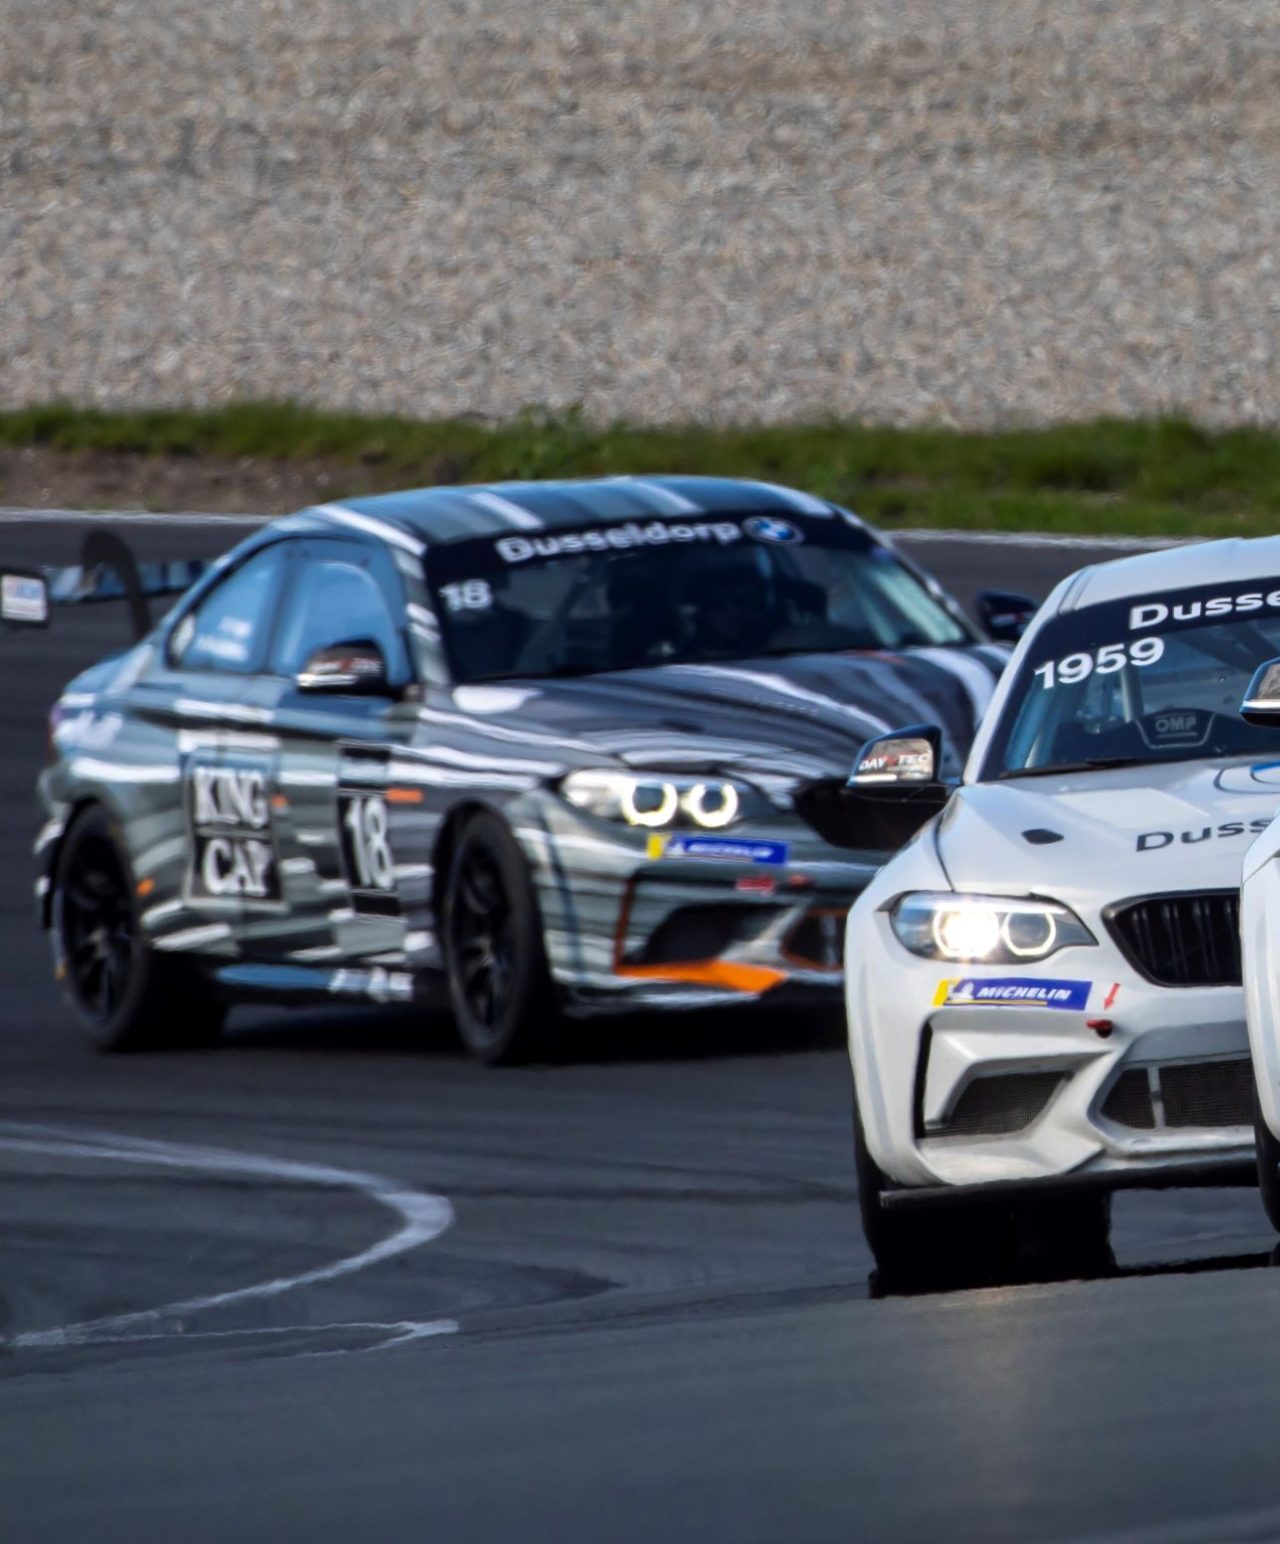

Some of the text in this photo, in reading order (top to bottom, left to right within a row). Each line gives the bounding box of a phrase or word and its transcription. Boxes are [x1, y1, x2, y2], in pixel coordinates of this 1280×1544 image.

[496, 521, 742, 563] Dusseldorp
[439, 579, 493, 611] 18
[1034, 636, 1165, 689] 1959
[1155, 716, 1197, 732] OMP
[193, 767, 268, 828] KING
[345, 797, 395, 890] 18
[976, 985, 1073, 1001] MICHELIN
